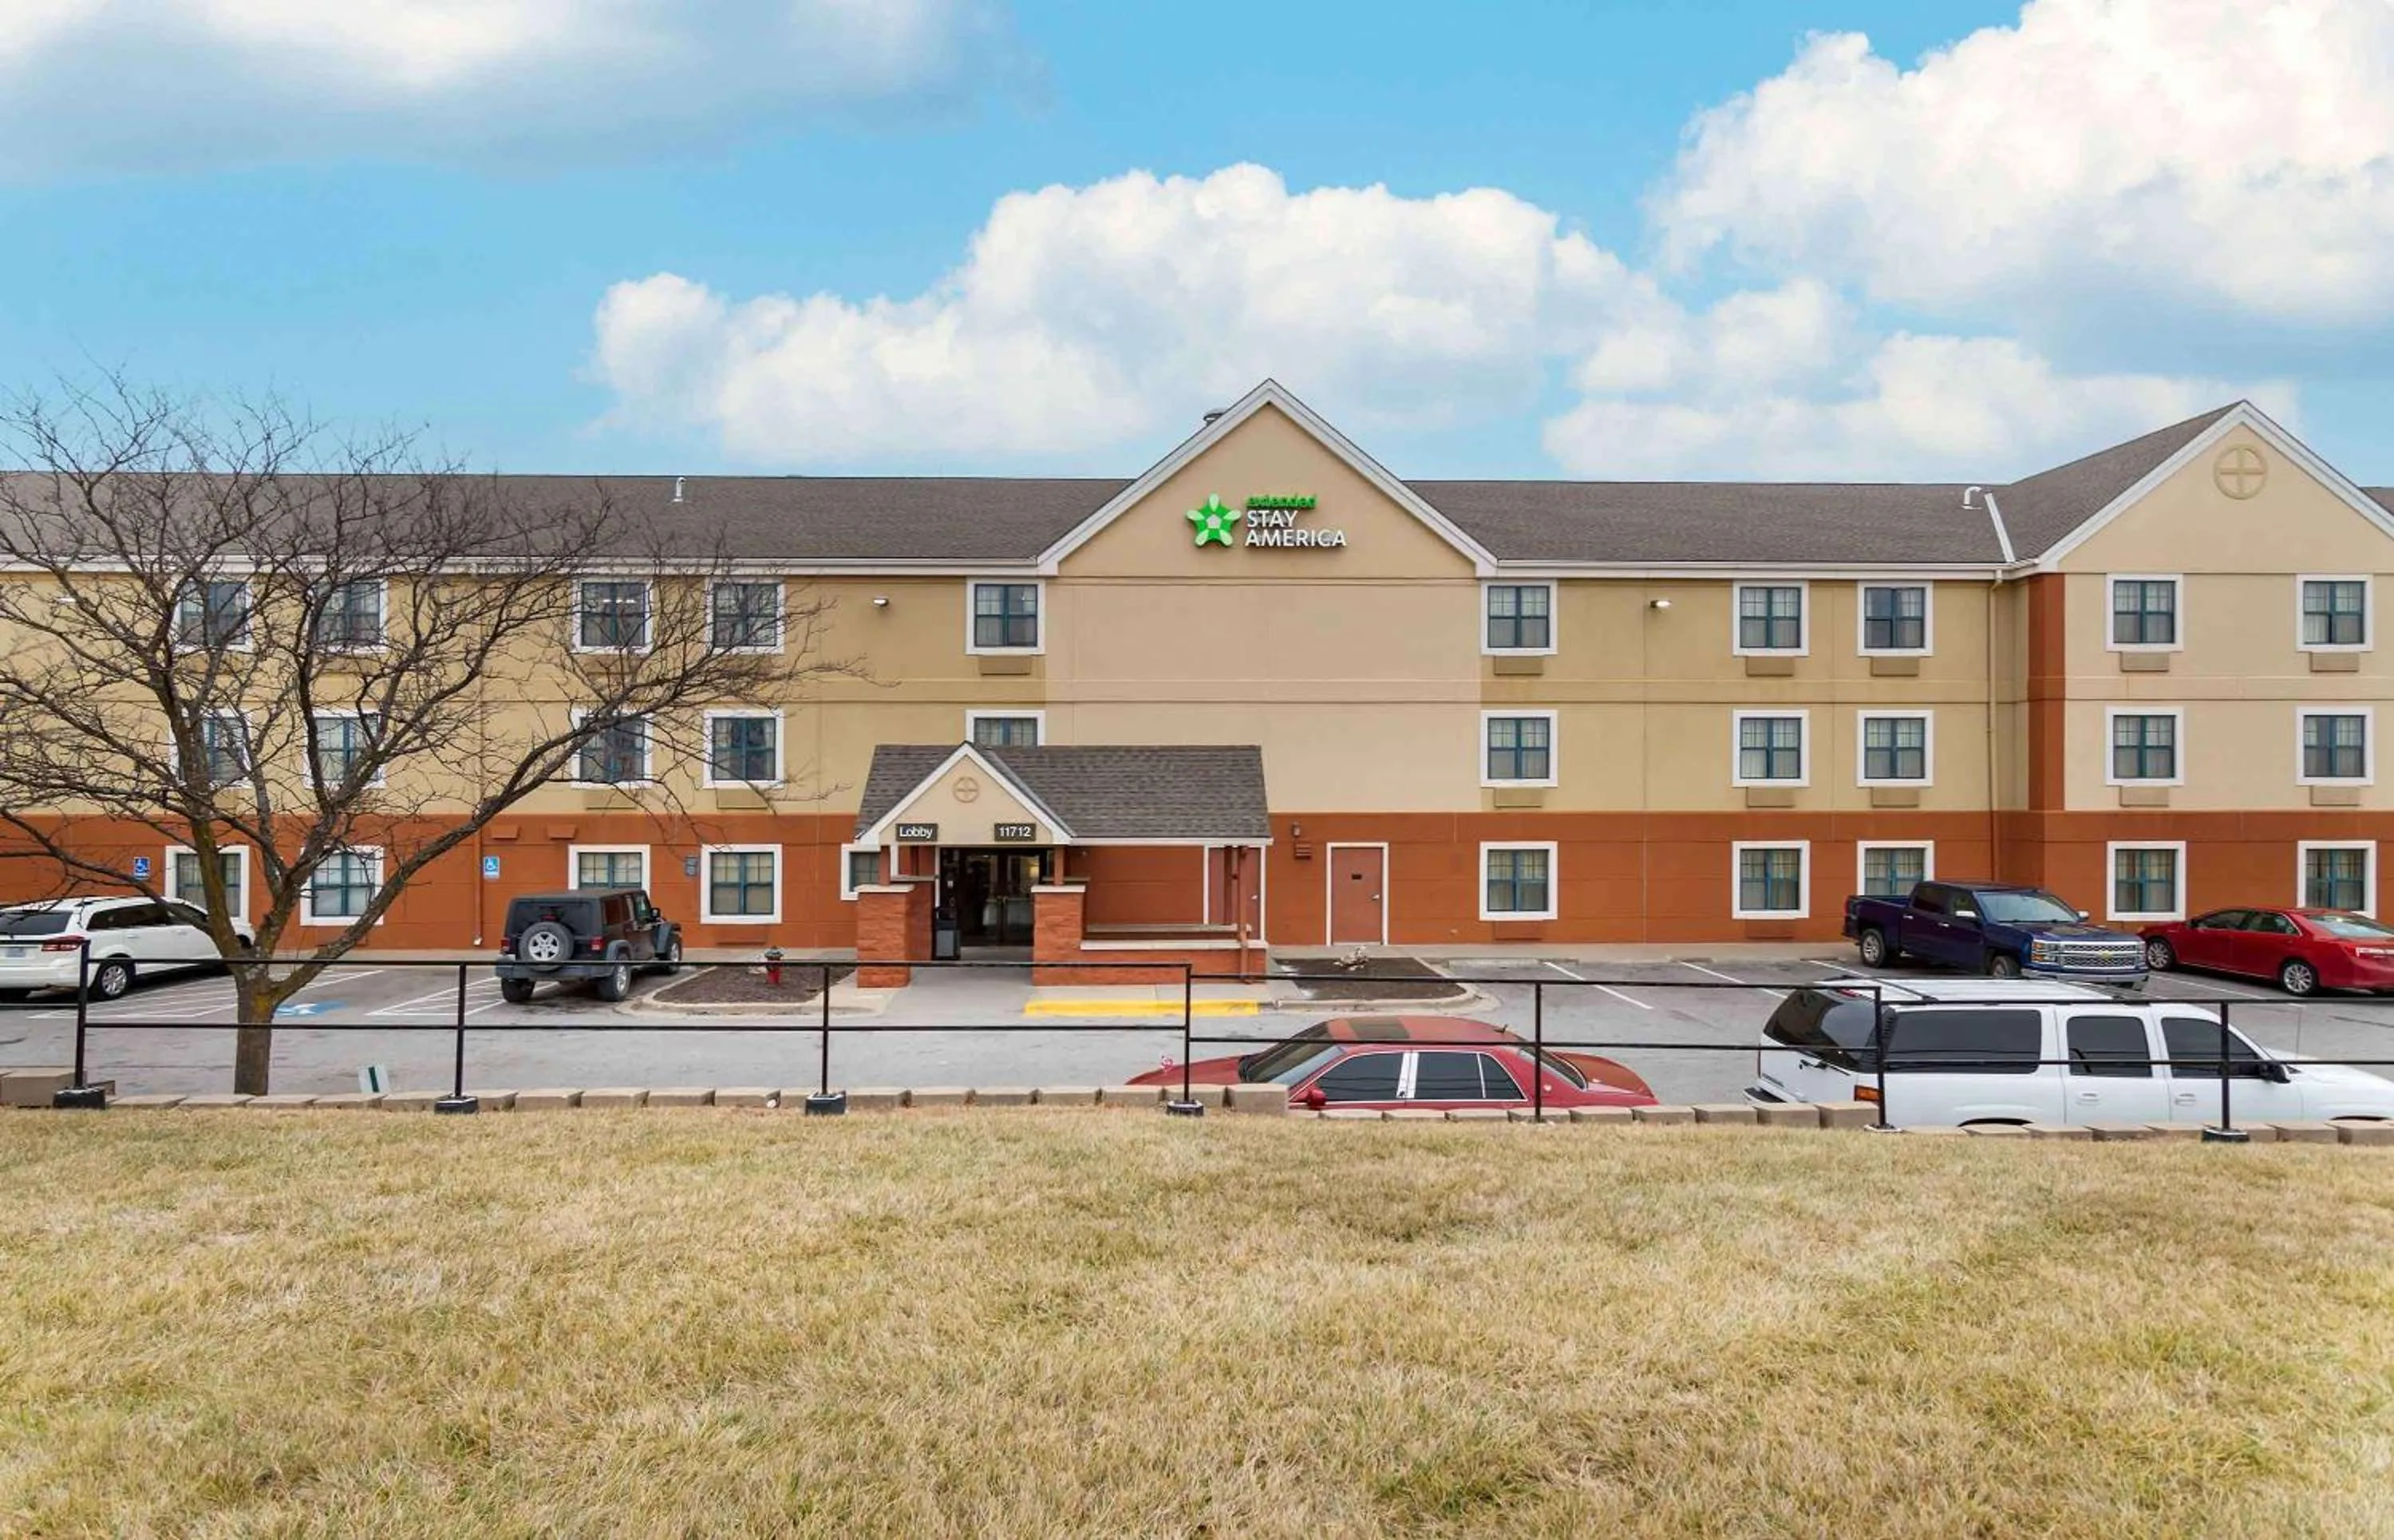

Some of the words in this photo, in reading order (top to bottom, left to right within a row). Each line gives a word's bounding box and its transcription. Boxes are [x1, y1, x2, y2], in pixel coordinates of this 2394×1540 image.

[1246, 510, 1298, 528] STAY
[1245, 529, 1347, 547] AMERICA
[899, 826, 933, 839] Lobby
[999, 826, 1031, 837] 11712
